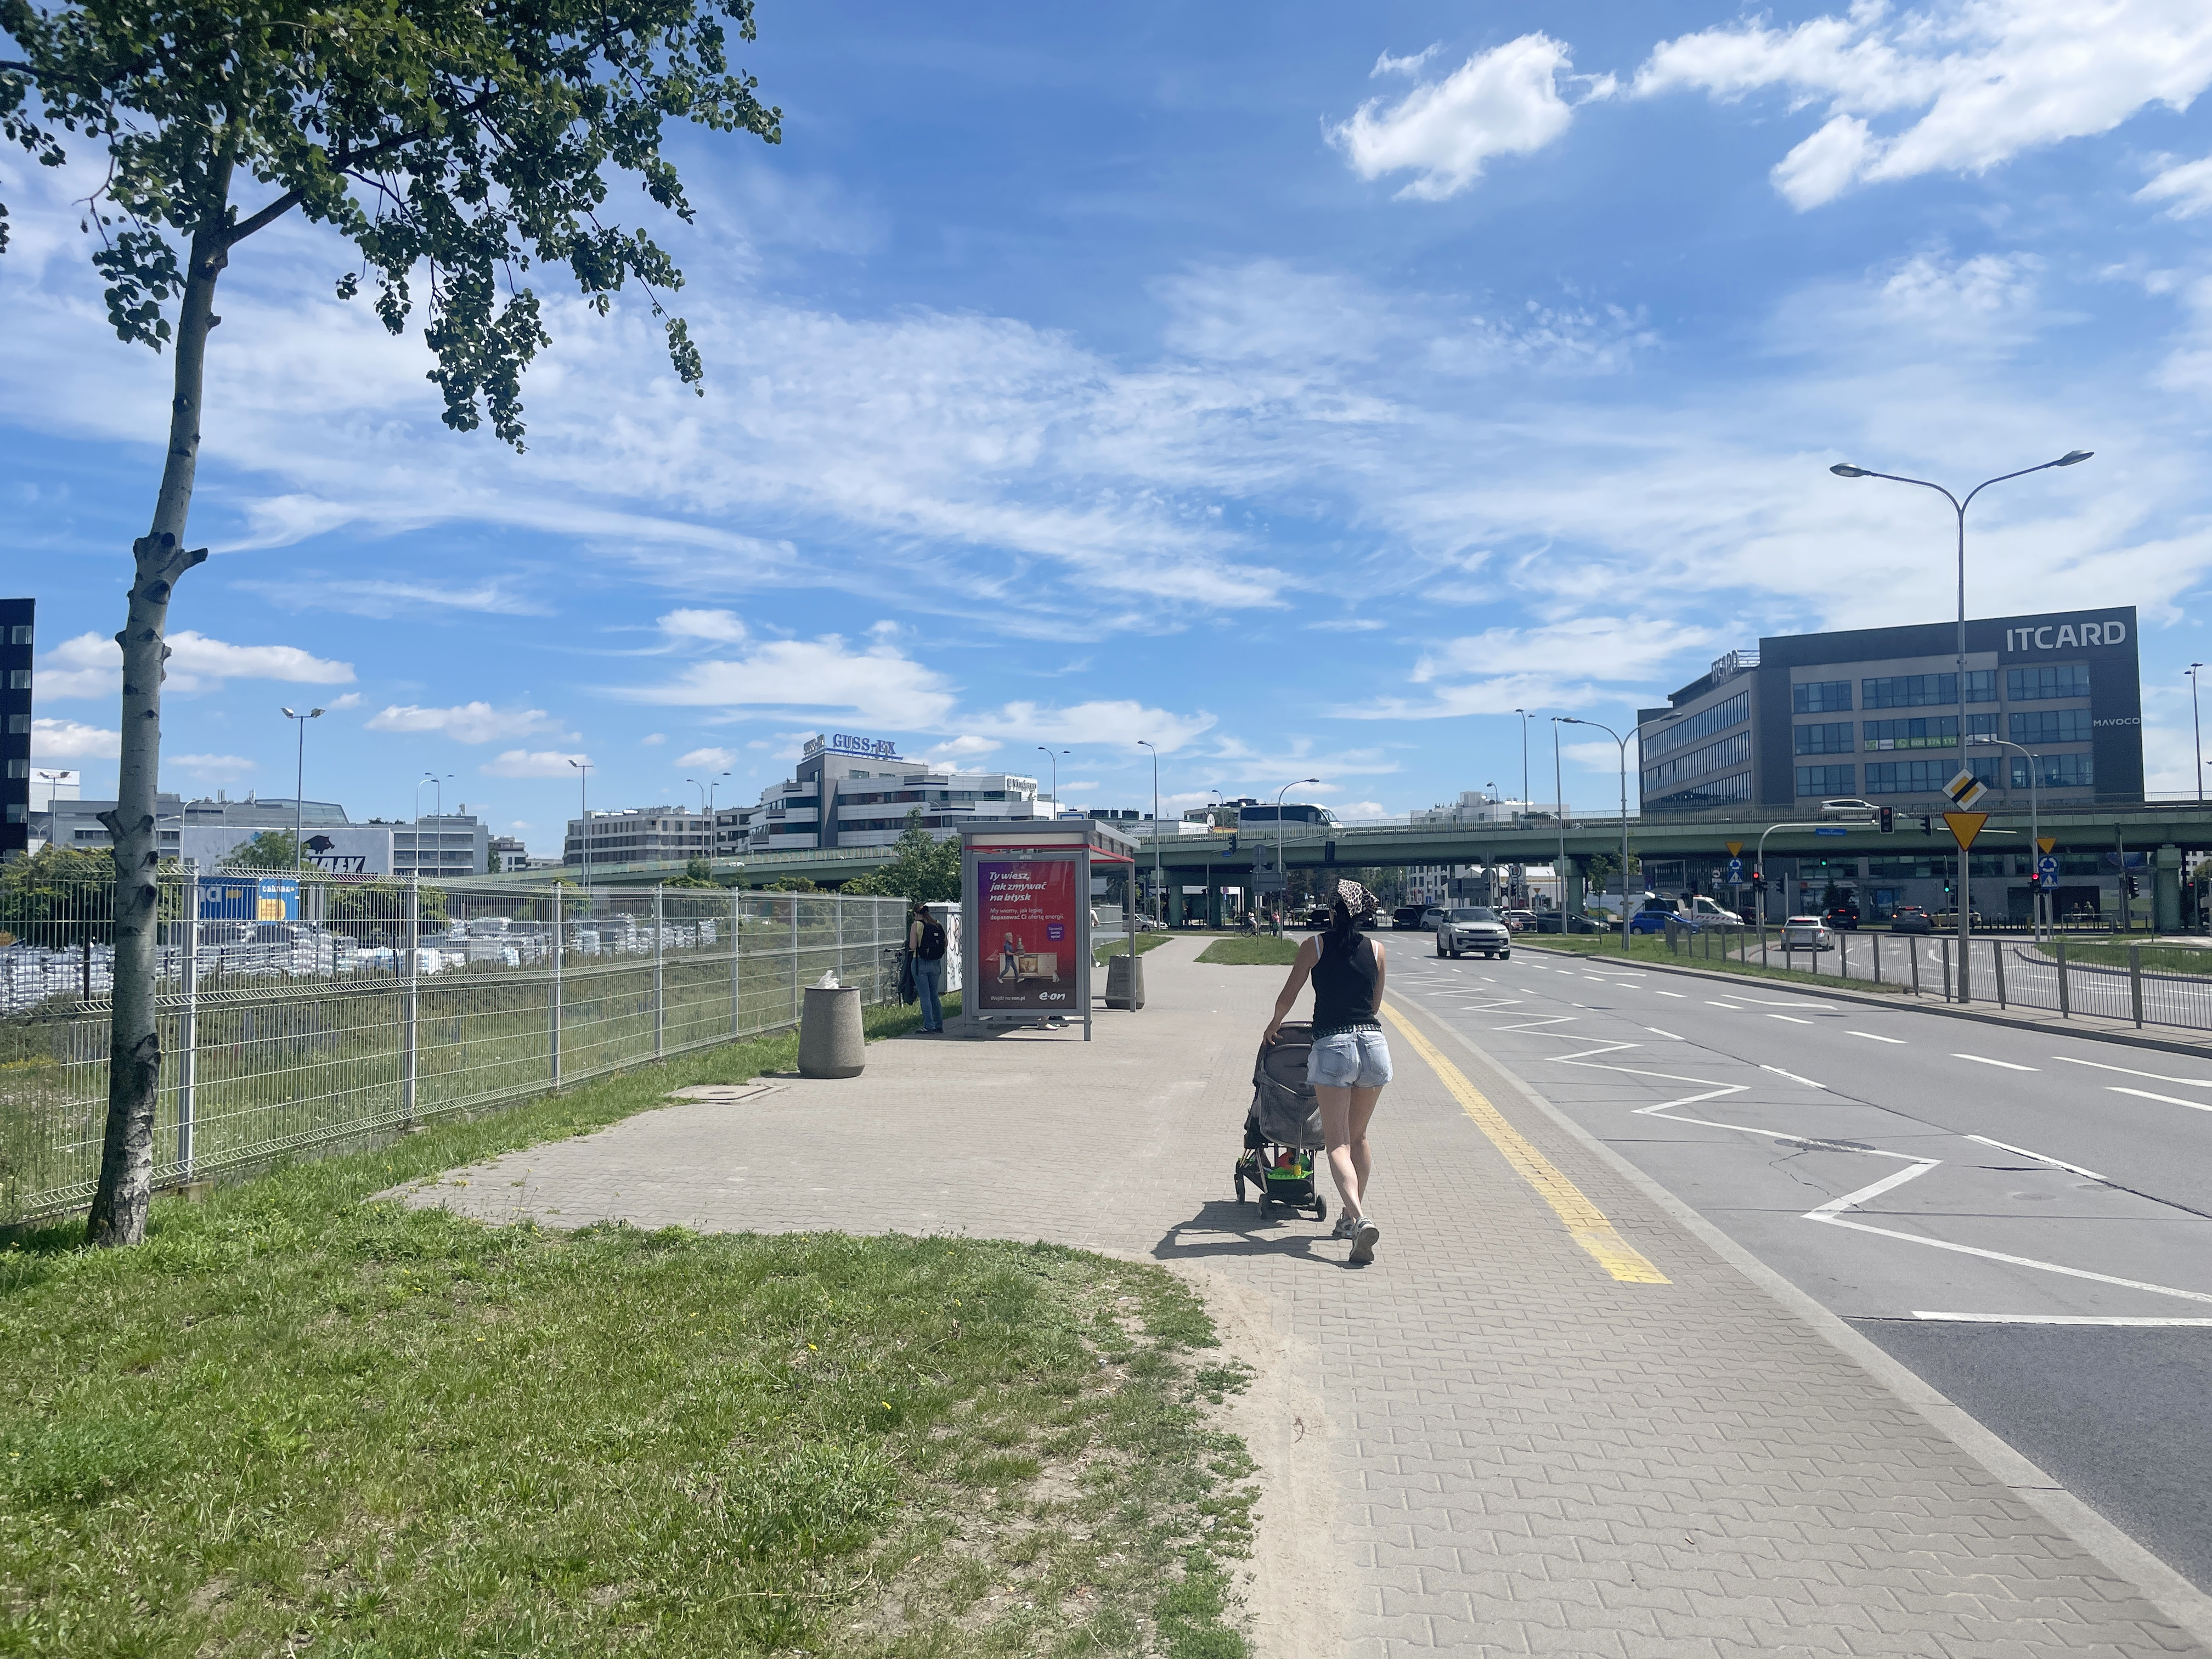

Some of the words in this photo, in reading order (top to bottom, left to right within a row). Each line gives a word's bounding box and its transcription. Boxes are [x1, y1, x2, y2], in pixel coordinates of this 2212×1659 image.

[2006, 621, 2126, 652] ITCARD
[2093, 718, 2141, 727] MAVOCO
[833, 733, 896, 755] GUSS-EX
[990, 872, 1000, 881] Ty
[1001, 871, 1030, 881] wiesz,
[990, 882, 1007, 892] jak
[1007, 882, 1047, 892] zmywać
[1004, 893, 1031, 902] błysk
